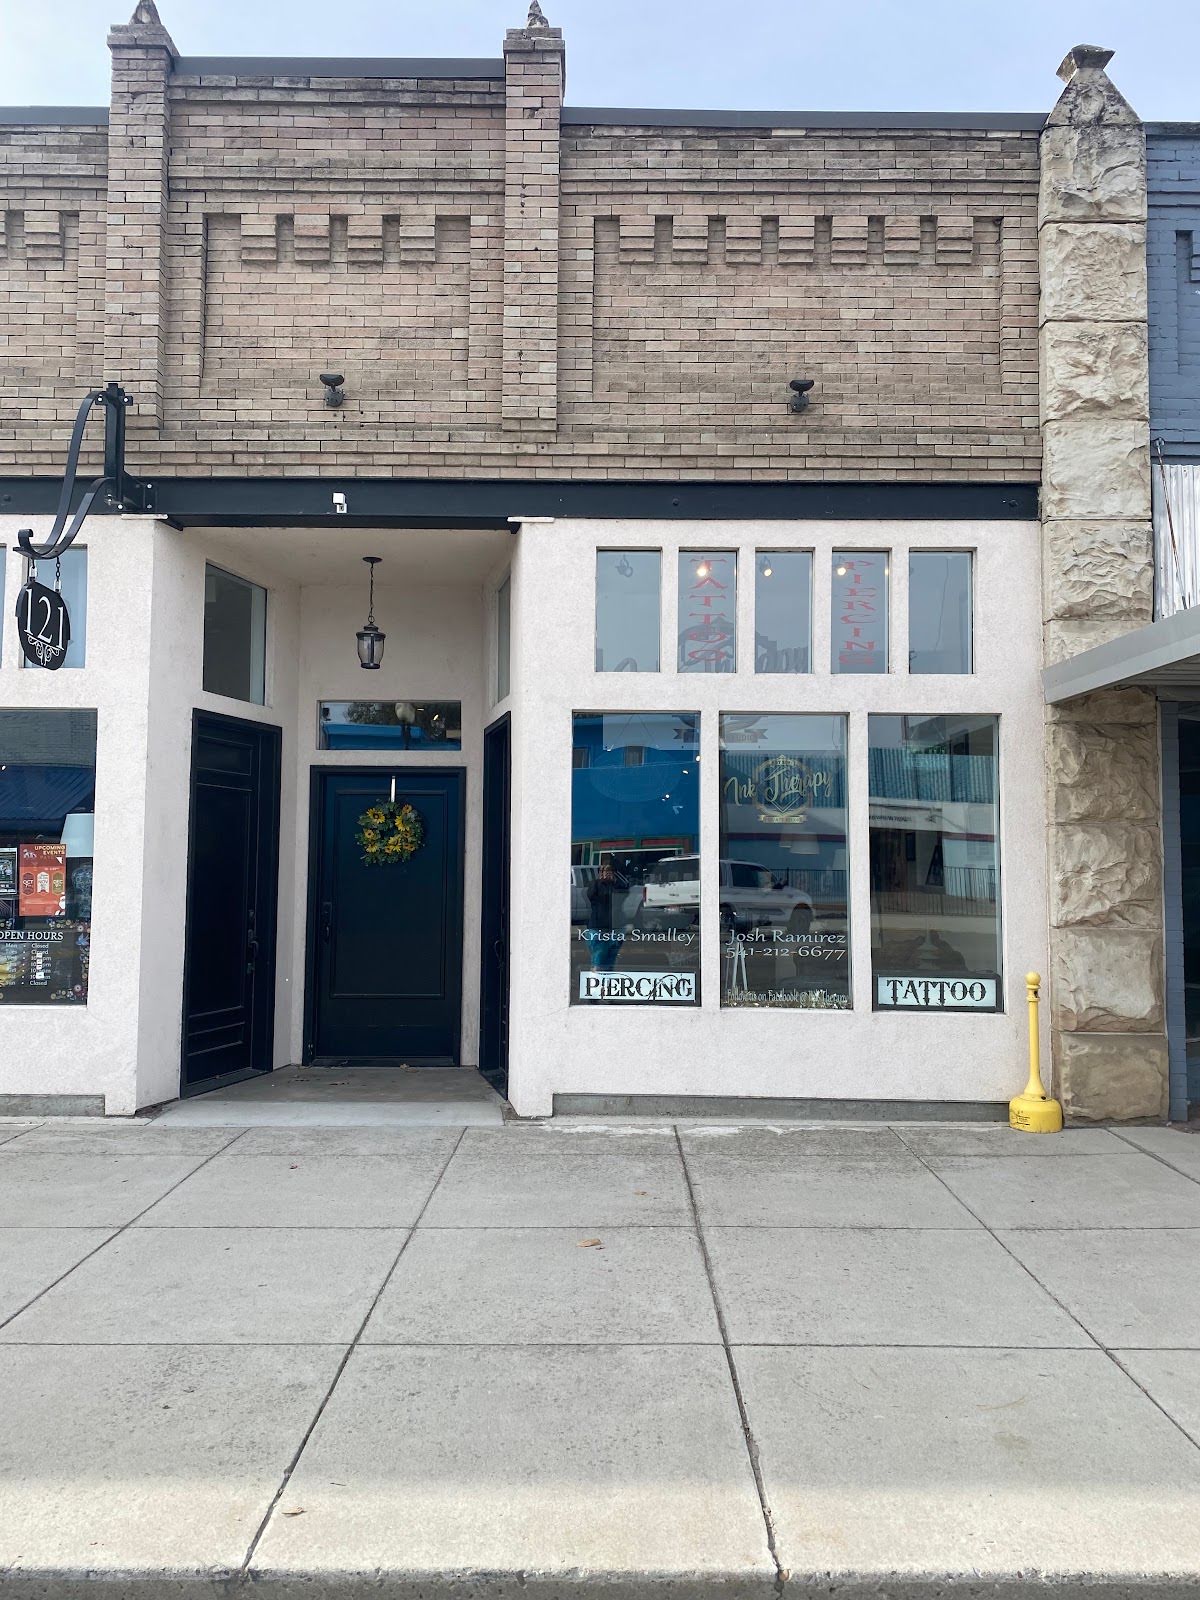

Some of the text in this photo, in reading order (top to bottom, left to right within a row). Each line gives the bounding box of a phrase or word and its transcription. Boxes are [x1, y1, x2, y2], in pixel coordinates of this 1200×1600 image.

[23, 588, 65, 651] 121
[688, 558, 728, 662] TATTOO
[838, 560, 879, 666] PIERCING
[723, 766, 834, 807] Ink Therapy
[27, 931, 64, 941] HOURS
[577, 928, 697, 947] Krista Smalley
[725, 929, 847, 946] Josh Ramirez
[725, 945, 847, 961] 541-212-6677
[583, 973, 694, 1000] PIERCING
[758, 993, 767, 1002] on
[768, 988, 799, 1002] Facebook
[886, 979, 988, 1005] TATTOO
